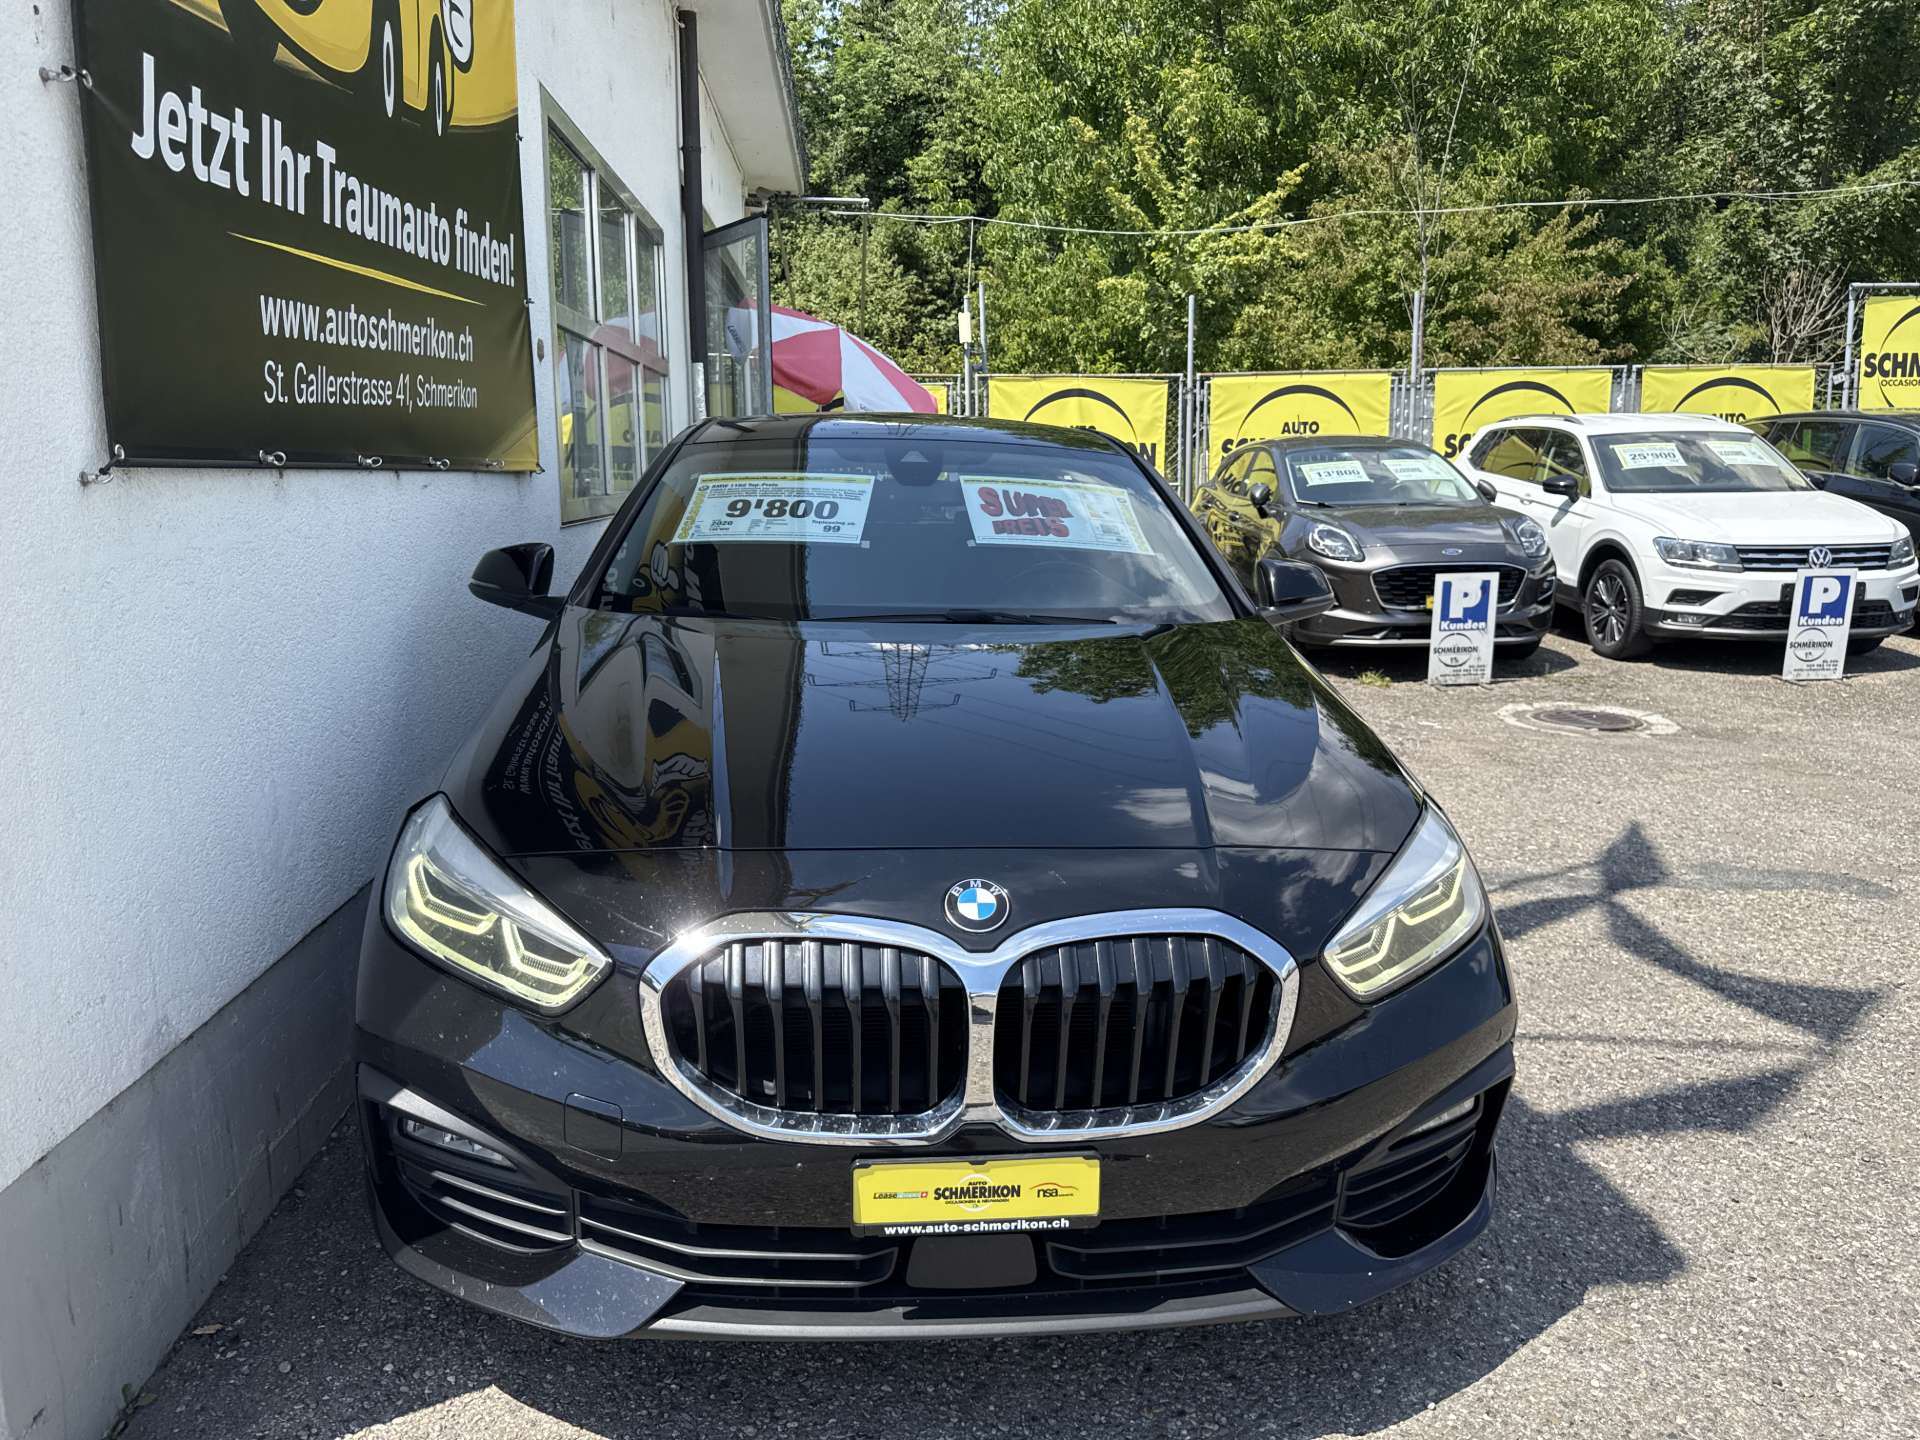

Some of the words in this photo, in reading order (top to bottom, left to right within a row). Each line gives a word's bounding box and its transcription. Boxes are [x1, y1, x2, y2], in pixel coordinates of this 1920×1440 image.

[131, 52, 250, 196] Jetzt
[261, 113, 311, 216] Ihr
[317, 139, 450, 265] Traumauto
[455, 208, 516, 287] finden!
[260, 294, 473, 362] www.autoschmerikon.ch
[263, 360, 288, 405] St.
[293, 365, 393, 406] Gallerstrasse
[396, 377, 412, 413] 41,
[416, 380, 478, 409] Schmerikon
[1881, 379, 1920, 387] OCCASIO
[1281, 420, 1320, 435] AUTO
[1629, 452, 1676, 460] 25'900
[726, 499, 840, 519] 9'800
[977, 486, 1074, 518] SUPER
[992, 517, 1070, 537] PREIS
[1441, 620, 1487, 631] Kunden
[1799, 615, 1843, 626] Kunden
[952, 880, 1003, 896] BMW
[933, 1184, 1021, 1201] SCHMERIKON
[1037, 1188, 1058, 1198] nsa
[884, 1217, 1070, 1235] www.auto-schmerikon.ch
